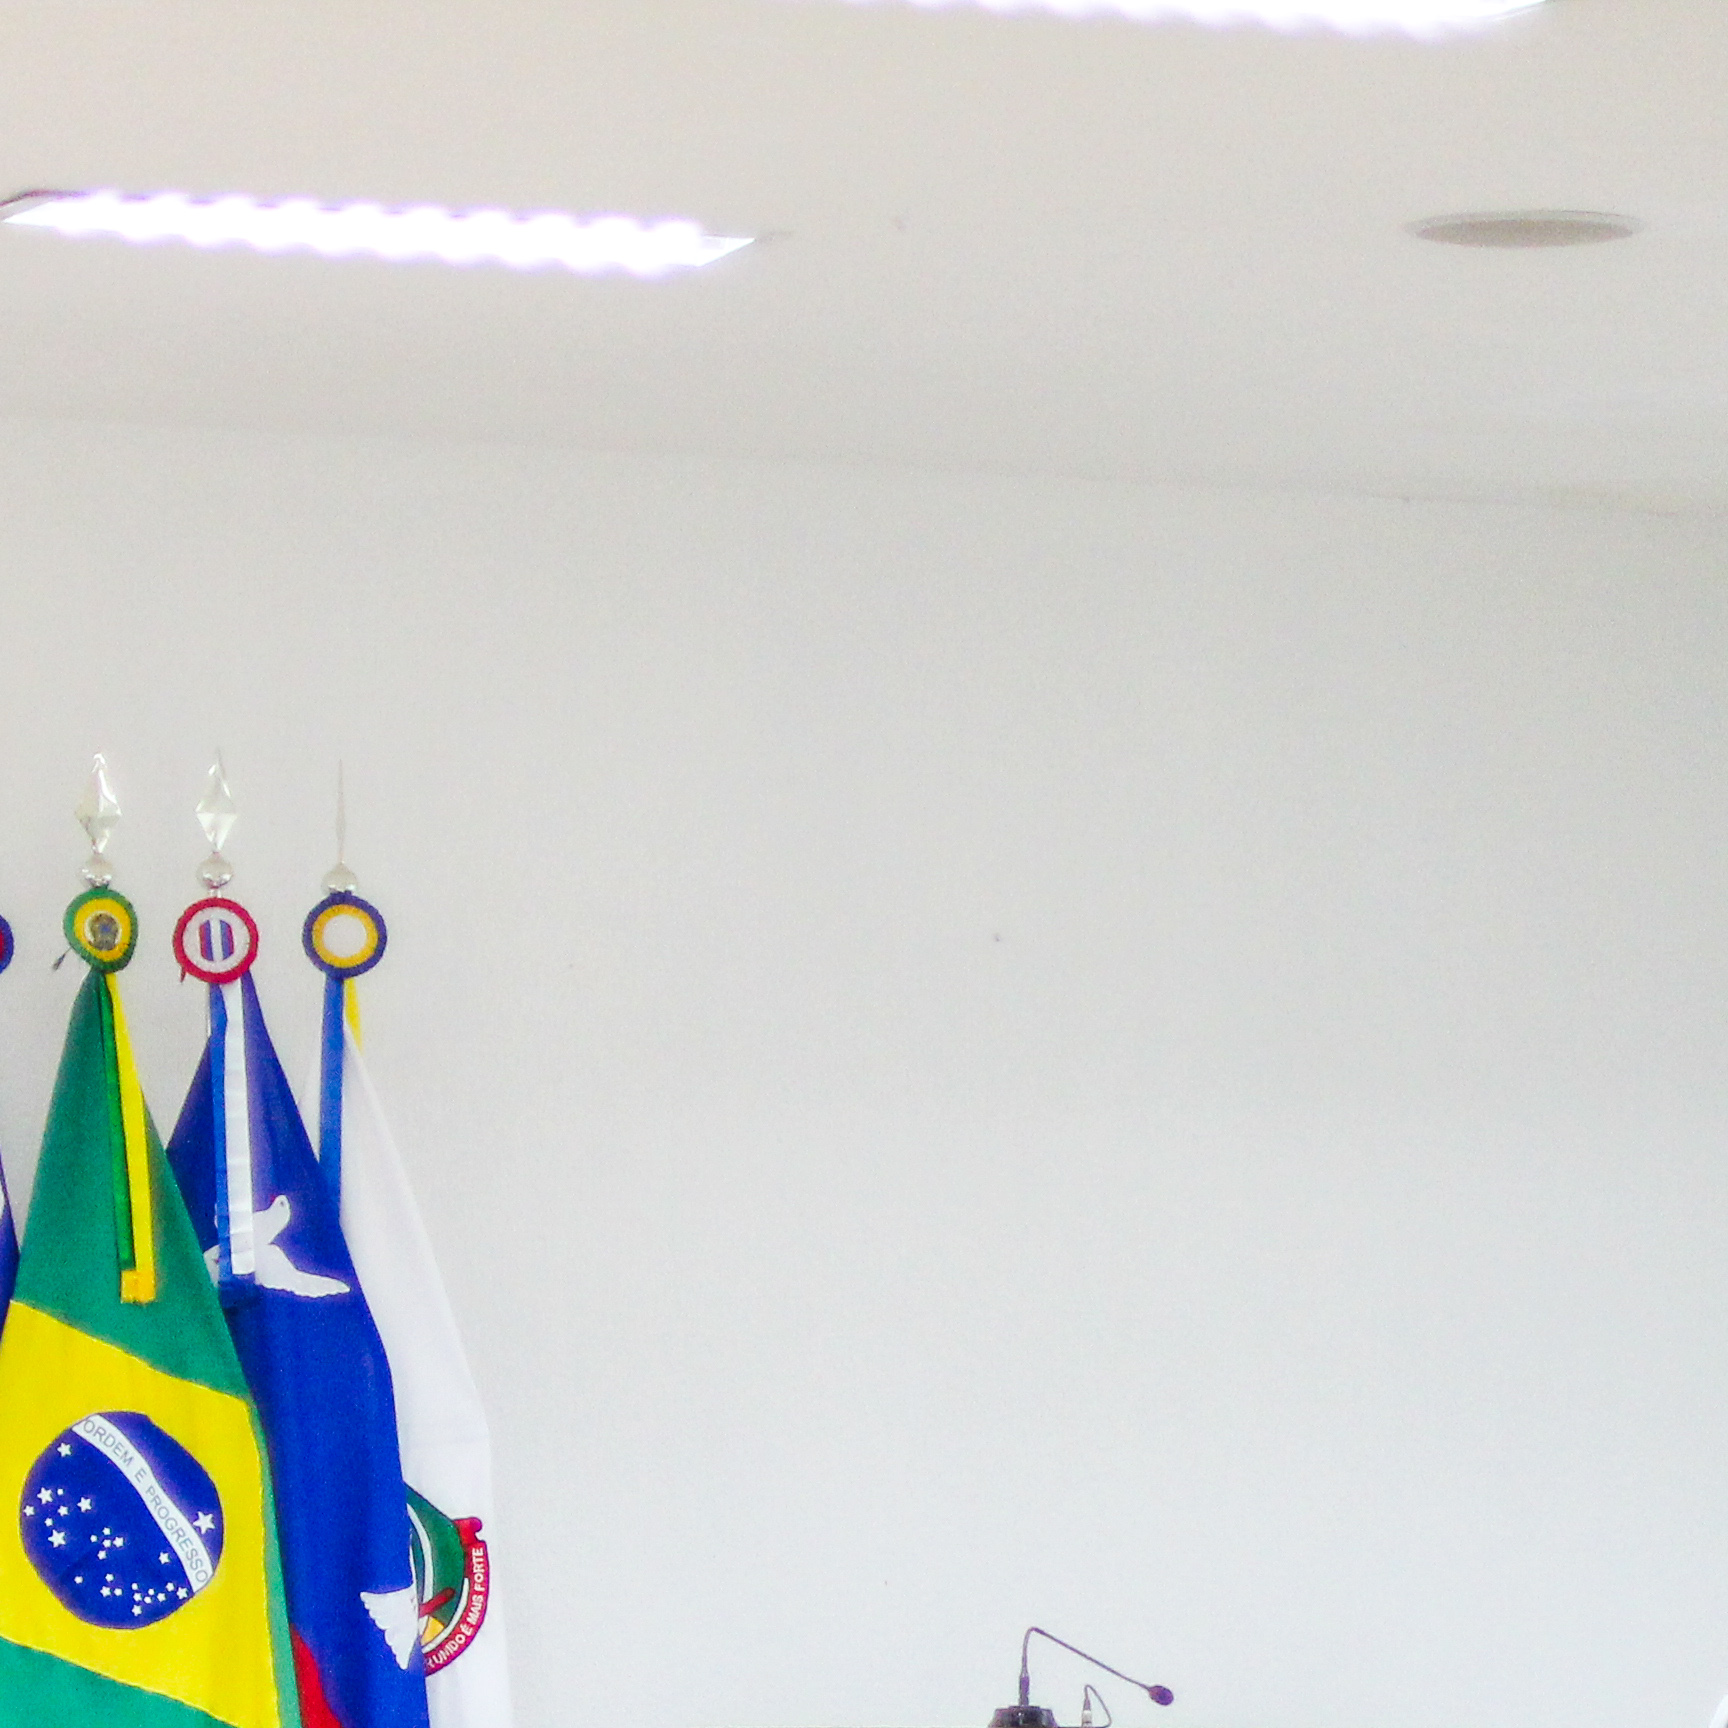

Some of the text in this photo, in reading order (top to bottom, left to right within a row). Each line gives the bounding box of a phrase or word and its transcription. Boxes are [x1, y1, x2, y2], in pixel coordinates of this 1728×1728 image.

[82, 1419, 209, 1584] ORDEM E PROGRESSO
[472, 1547, 487, 1593] FORTE
[466, 1594, 484, 1626] MAIS
[432, 1633, 466, 1664] UNIDO
